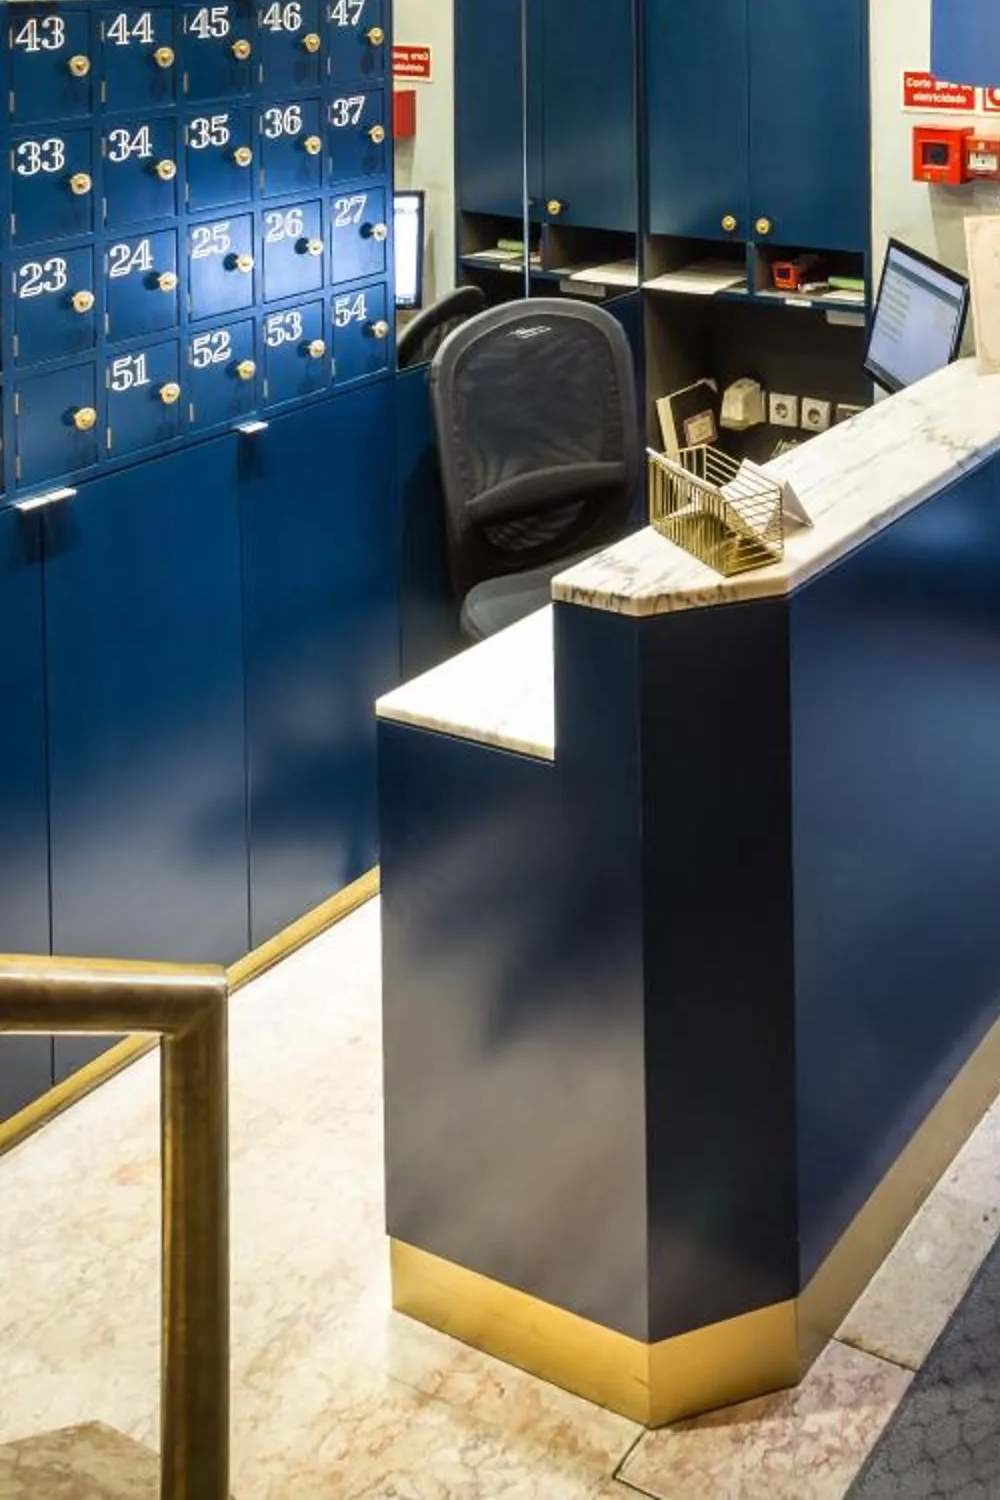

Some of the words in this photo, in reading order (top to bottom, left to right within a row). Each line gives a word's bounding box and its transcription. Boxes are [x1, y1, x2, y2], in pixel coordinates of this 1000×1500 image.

[15, 16, 65, 52] 43
[107, 12, 154, 45] 44
[189, 5, 230, 39] 45
[263, 2, 302, 31] 46
[265, 105, 302, 139] 36
[333, 95, 365, 127] 37
[109, 126, 153, 162] 34
[190, 114, 229, 149] 35
[17, 138, 65, 176] 33
[266, 209, 303, 243] 26
[334, 195, 367, 228] 27
[109, 239, 153, 278] 24
[191, 223, 231, 259] 25
[19, 257, 67, 299] 23
[335, 293, 367, 327] 54
[267, 311, 302, 347] 53
[193, 330, 231, 368] 52
[111, 353, 150, 391] 51
